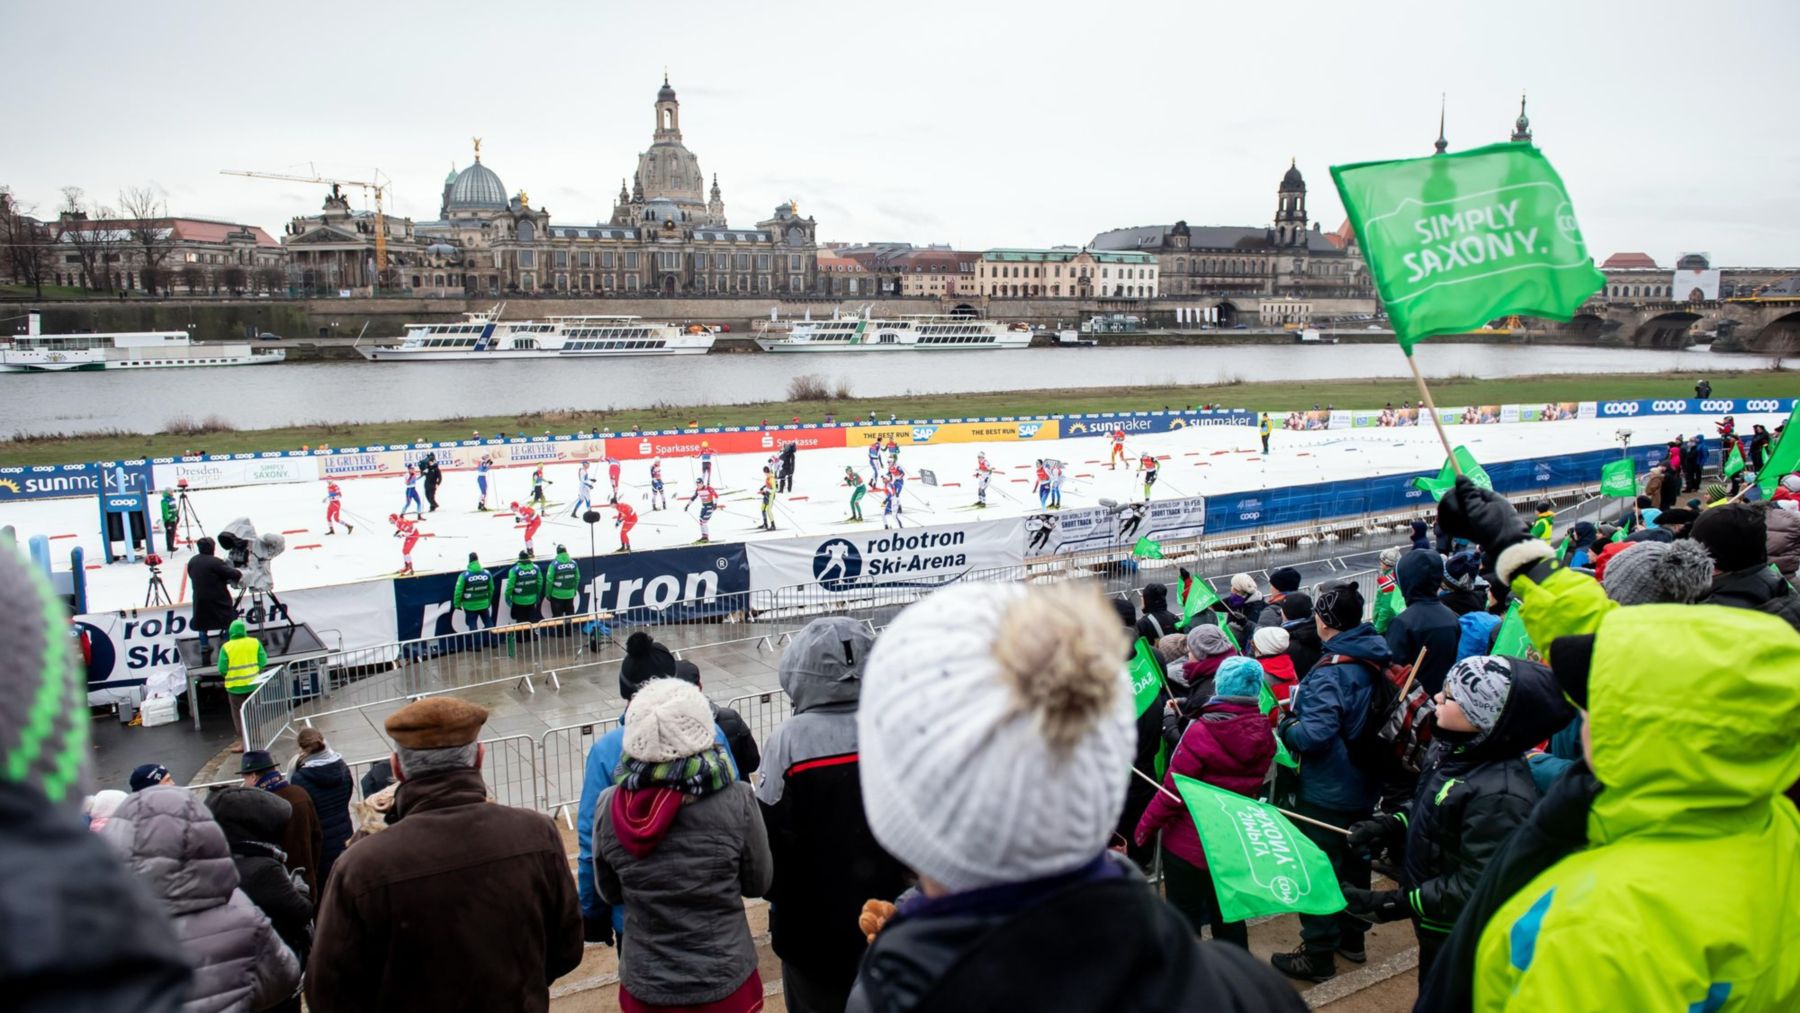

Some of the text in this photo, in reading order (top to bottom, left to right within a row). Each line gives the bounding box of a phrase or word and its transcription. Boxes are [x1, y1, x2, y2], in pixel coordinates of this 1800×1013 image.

[1415, 199, 1520, 244] SIMPLY
[1403, 227, 1548, 283] SAXONY.
[1604, 402, 1639, 415] coop
[1652, 400, 1686, 413] coop
[1700, 400, 1733, 413] coop
[1746, 399, 1779, 412] coop
[1018, 423, 1039, 436] SAP
[1090, 417, 1152, 432] sunmaker
[913, 428, 934, 440] SAP
[656, 444, 700, 454] Sparkasse
[1240, 512, 1260, 520] coop
[867, 530, 965, 554] robotron
[868, 551, 966, 576] Ski-Arena
[468, 574, 488, 582] coop
